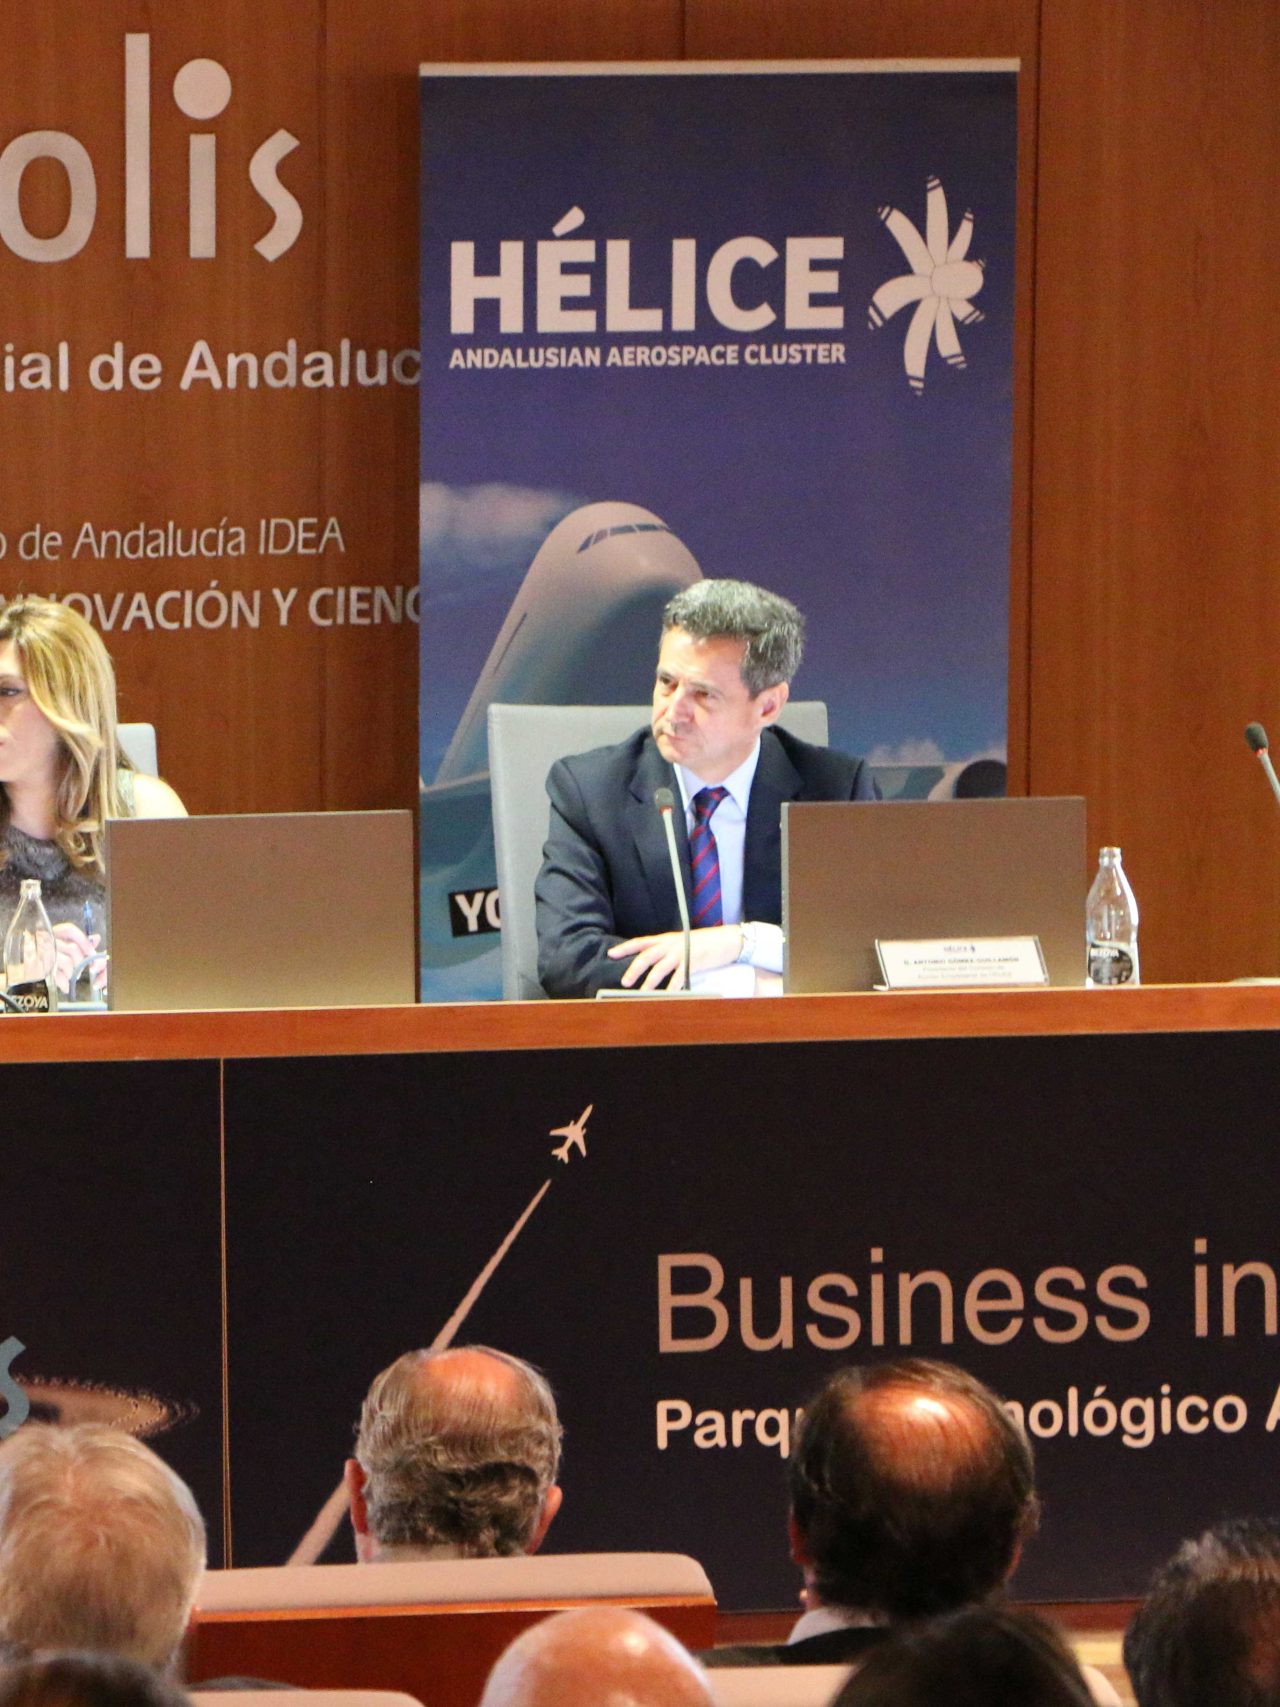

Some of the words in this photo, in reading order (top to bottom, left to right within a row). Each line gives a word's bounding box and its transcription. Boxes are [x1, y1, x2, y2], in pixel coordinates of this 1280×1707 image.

[450, 206, 845, 335] HÉLICE
[88, 341, 163, 392] de
[448, 346, 601, 370] ANDALUSIAN
[605, 344, 739, 368] AEROSPACE
[744, 342, 846, 367] CLUSTER
[22, 523, 63, 561] de
[71, 516, 246, 560] Andalucía
[258, 516, 345, 556] IDEA
[271, 586, 298, 627] Y
[657, 1247, 1151, 1354] Business
[1194, 1238, 1278, 1338] in
